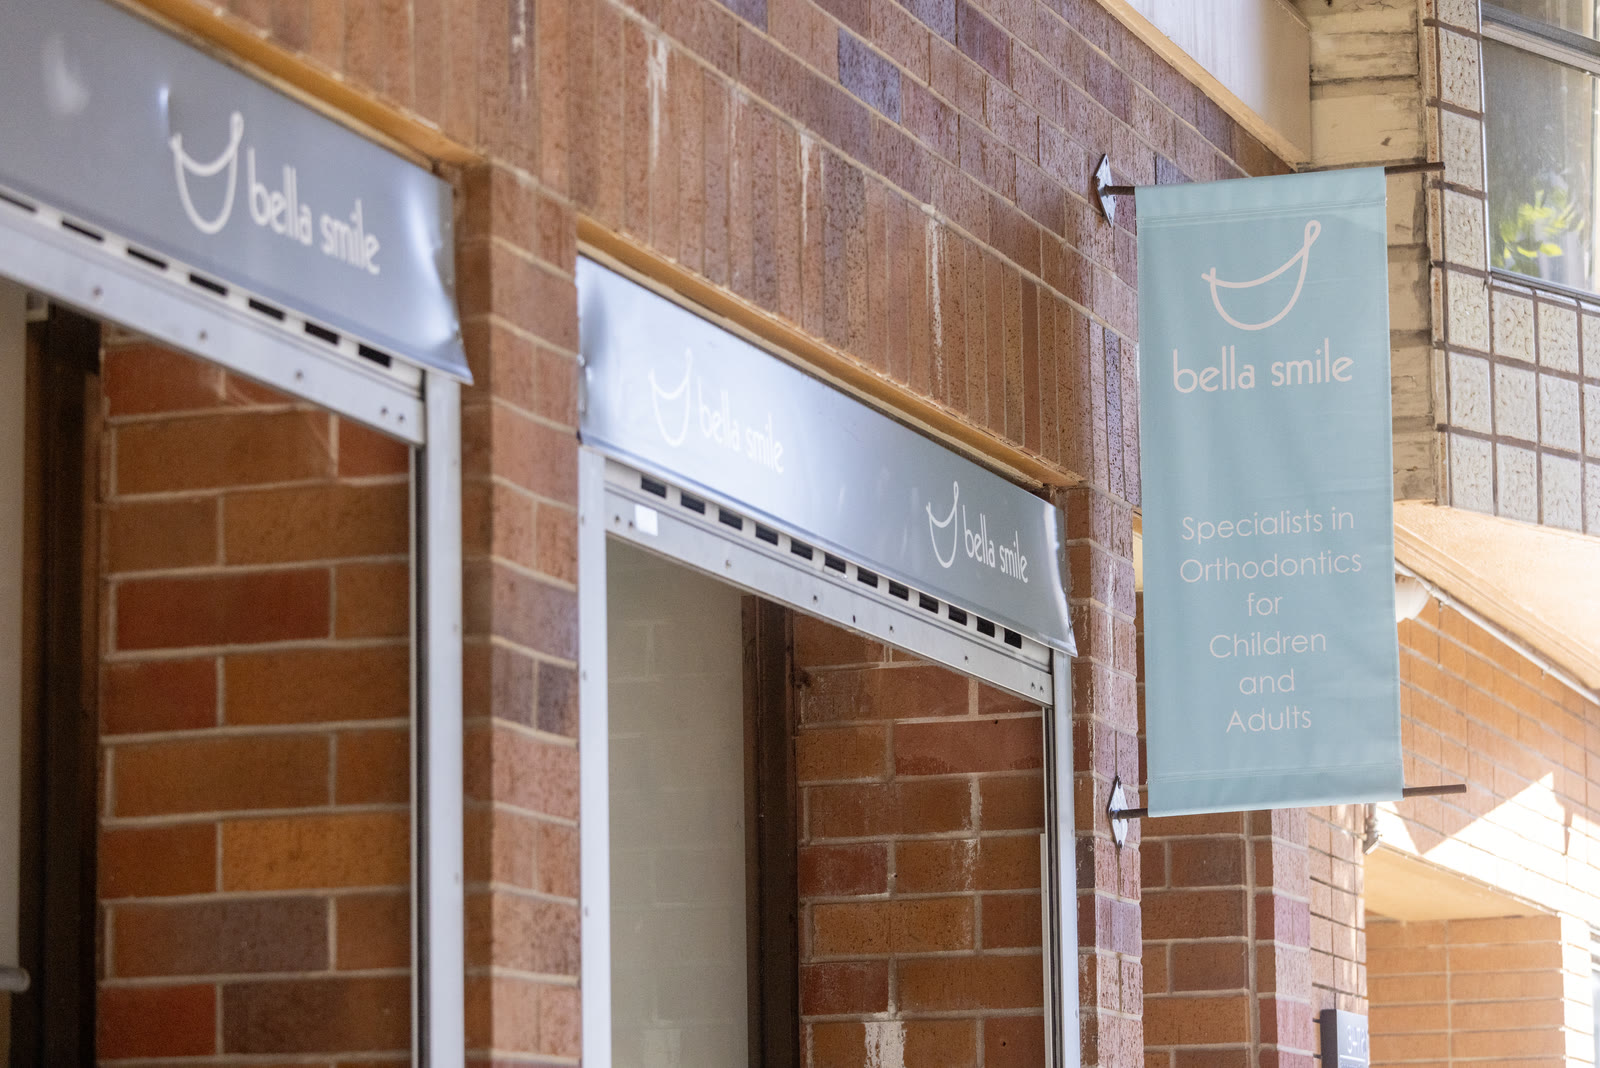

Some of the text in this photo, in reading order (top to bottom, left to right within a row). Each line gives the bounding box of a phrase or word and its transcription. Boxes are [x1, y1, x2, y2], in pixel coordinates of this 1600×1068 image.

[247, 147, 381, 275] bella smile
[1173, 338, 1354, 393] bella smile
[697, 375, 785, 474] bella smile
[1181, 506, 1354, 544] Specialists in
[962, 504, 1029, 584] bella smile
[1180, 550, 1362, 583] Orthodontics
[1246, 592, 1284, 617] for
[1209, 631, 1327, 659] Children
[1239, 667, 1296, 695] and
[1225, 705, 1312, 733] Adults
